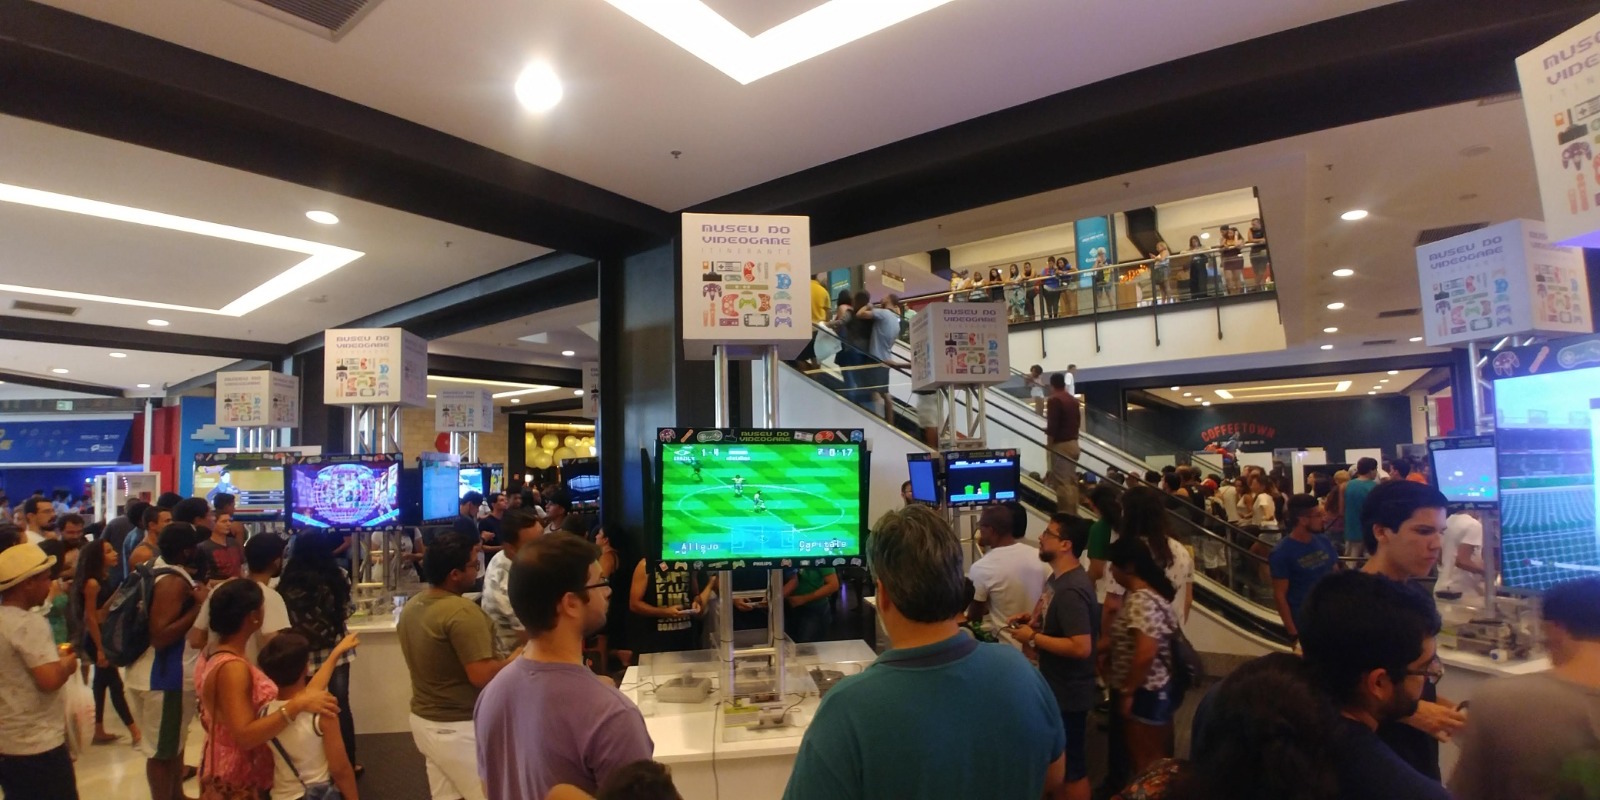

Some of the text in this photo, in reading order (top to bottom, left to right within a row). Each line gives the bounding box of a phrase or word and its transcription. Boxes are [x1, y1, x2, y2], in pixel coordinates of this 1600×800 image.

[702, 224, 791, 234] MUSEU DO
[702, 236, 791, 245] VIDEOGAME
[1428, 235, 1503, 262] MUSEU DO
[1430, 245, 1504, 270] VIDEOGAME
